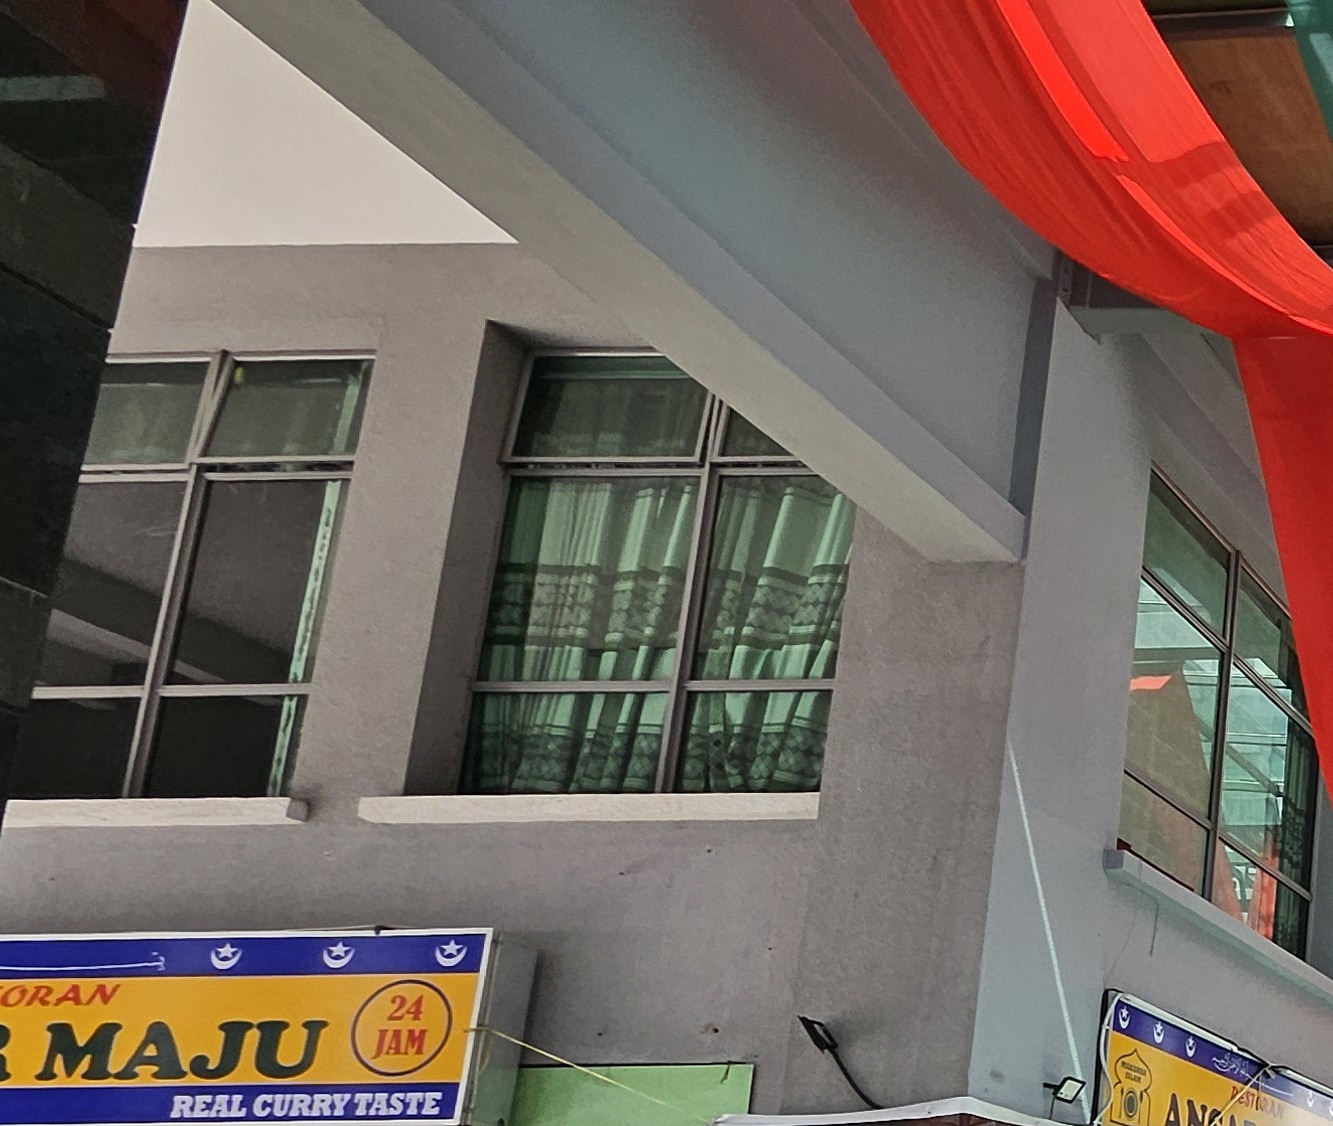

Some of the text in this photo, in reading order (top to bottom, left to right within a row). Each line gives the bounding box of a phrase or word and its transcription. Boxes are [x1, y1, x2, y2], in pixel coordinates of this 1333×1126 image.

[0, 983, 121, 1007] ORAN
[390, 995, 424, 1022] 24
[34, 1020, 330, 1081] MAJU
[371, 1028, 428, 1060] JAM
[170, 1091, 443, 1119] REAL CURRY TASTE
